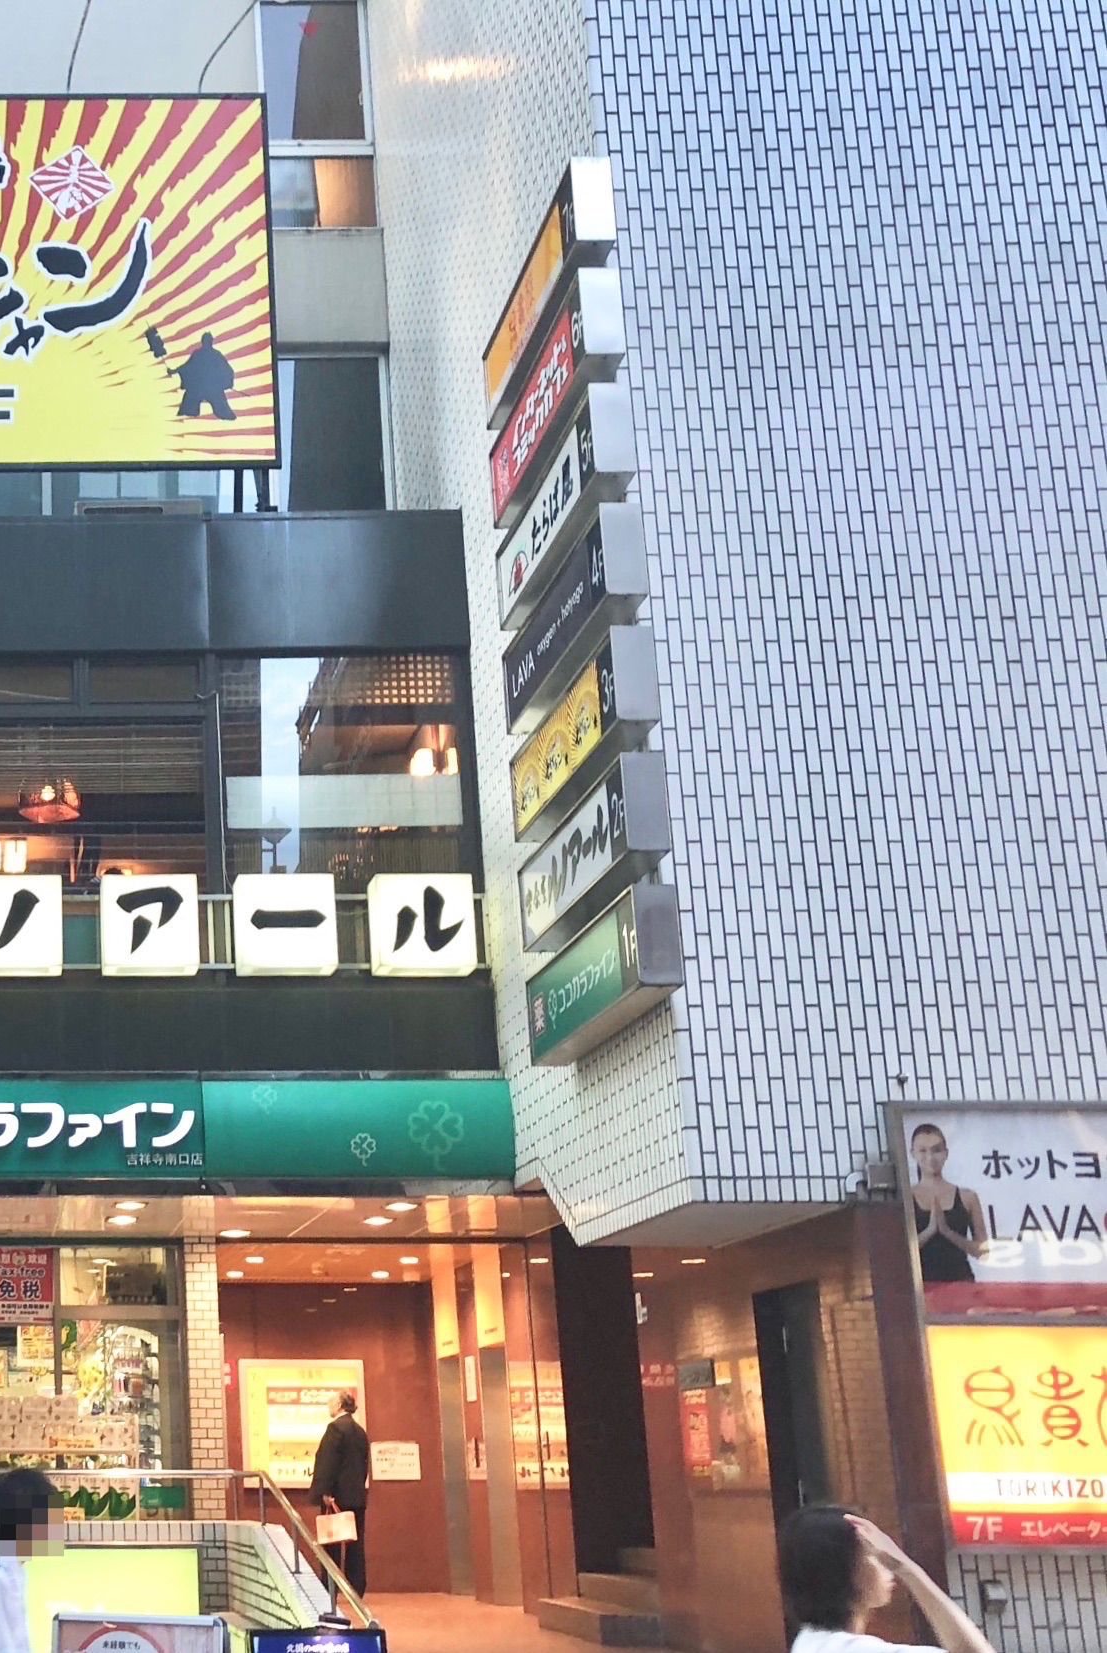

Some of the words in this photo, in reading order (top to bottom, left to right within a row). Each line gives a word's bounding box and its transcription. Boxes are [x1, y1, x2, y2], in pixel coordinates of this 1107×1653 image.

[512, 650, 535, 698] LAVA
[536, 626, 558, 656] oxygen
[548, 803, 609, 909] ルノアール
[622, 923, 636, 968] 1F
[558, 948, 617, 1014] ココカラファイン
[125, 1152, 204, 1167] 吉祥寺南口店
[981, 1149, 1107, 1181] ホットヨ
[987, 1203, 1104, 1243] LAVA
[996, 1478, 1107, 1499] TORIKIZO
[966, 1515, 1003, 1541] 7F
